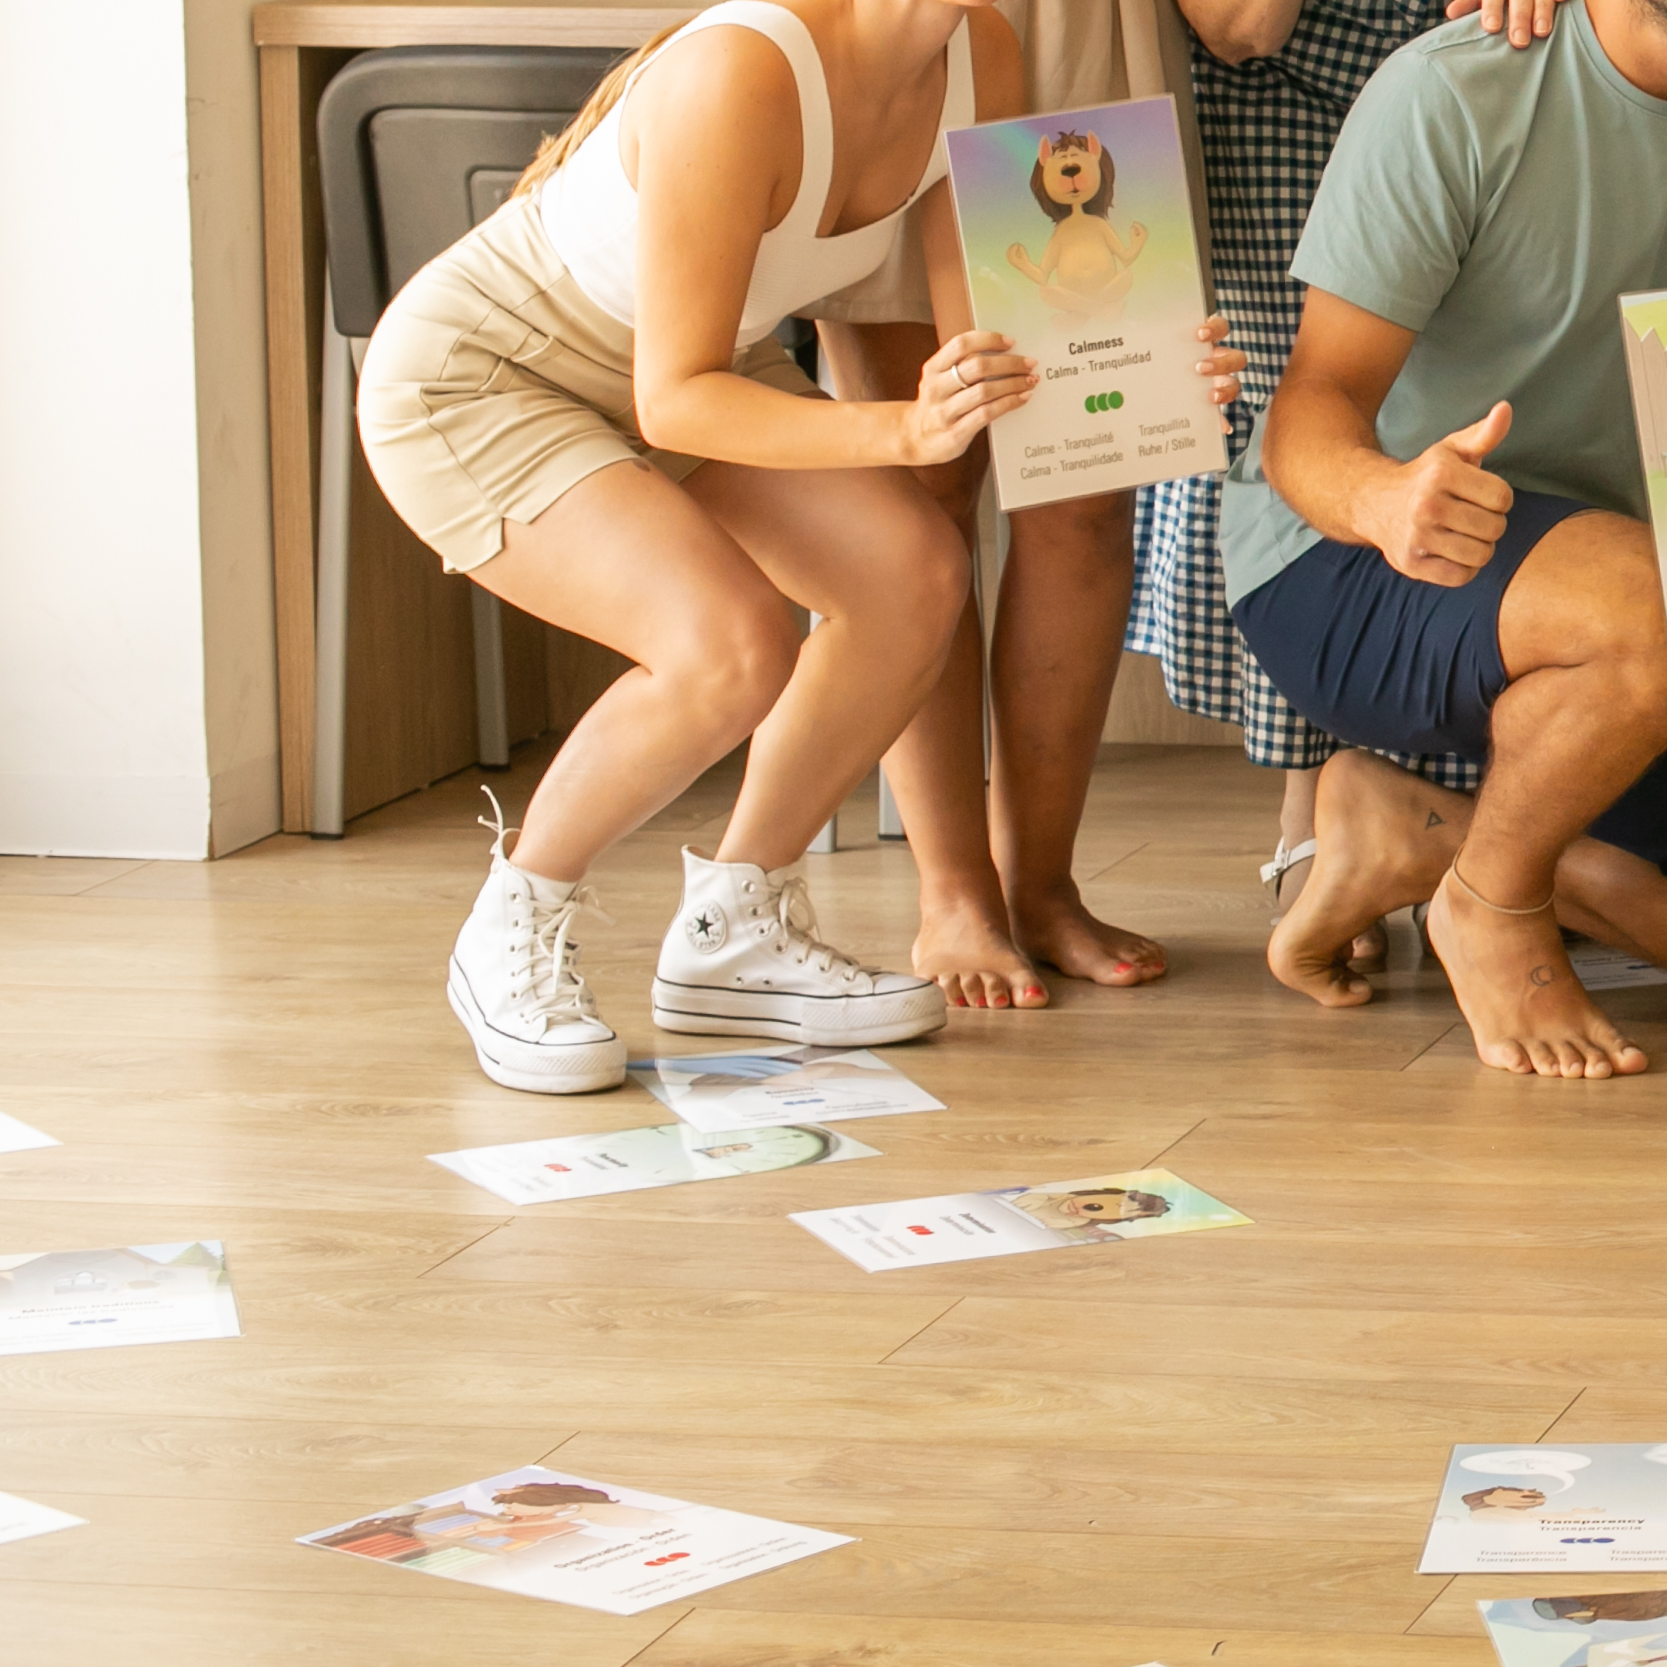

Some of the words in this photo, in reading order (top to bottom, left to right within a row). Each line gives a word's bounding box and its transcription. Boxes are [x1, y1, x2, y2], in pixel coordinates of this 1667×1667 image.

[1068, 336, 1125, 356] Calmness
[1045, 361, 1079, 381] Calma
[1087, 350, 1152, 373] Tranquilidad
[1138, 417, 1191, 437] Tranquillità
[1024, 439, 1055, 459] Calme
[1063, 431, 1115, 451] Tranquilité
[1137, 443, 1163, 458] Ruhe
[1171, 436, 1197, 451] Stille
[1020, 465, 1052, 481] Calma
[1059, 450, 1124, 472] Tranquilidade
